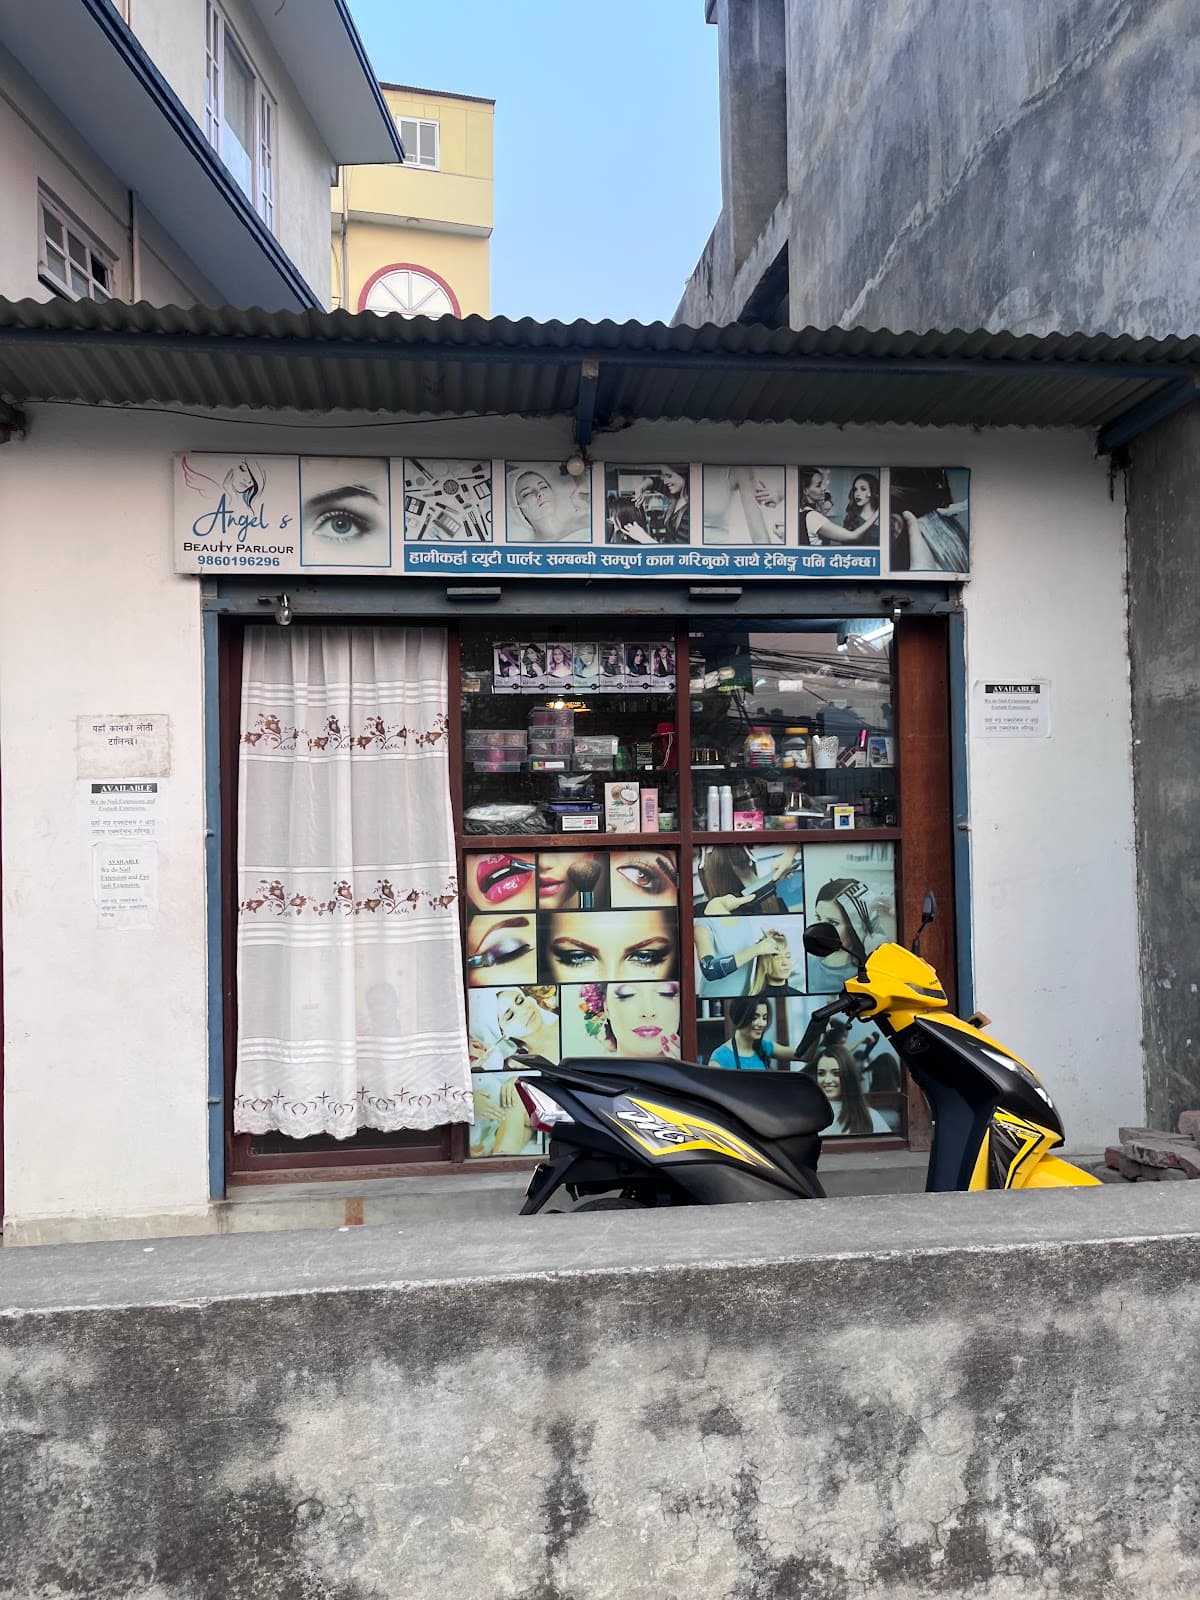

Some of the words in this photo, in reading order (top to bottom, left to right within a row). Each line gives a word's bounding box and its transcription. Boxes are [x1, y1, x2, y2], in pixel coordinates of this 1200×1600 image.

[192, 493, 269, 542] Angel
[236, 544, 294, 554] PARLOUR
[197, 555, 280, 567] 9860196296
[645, 555, 674, 566] काम
[802, 554, 826, 568] पनि
